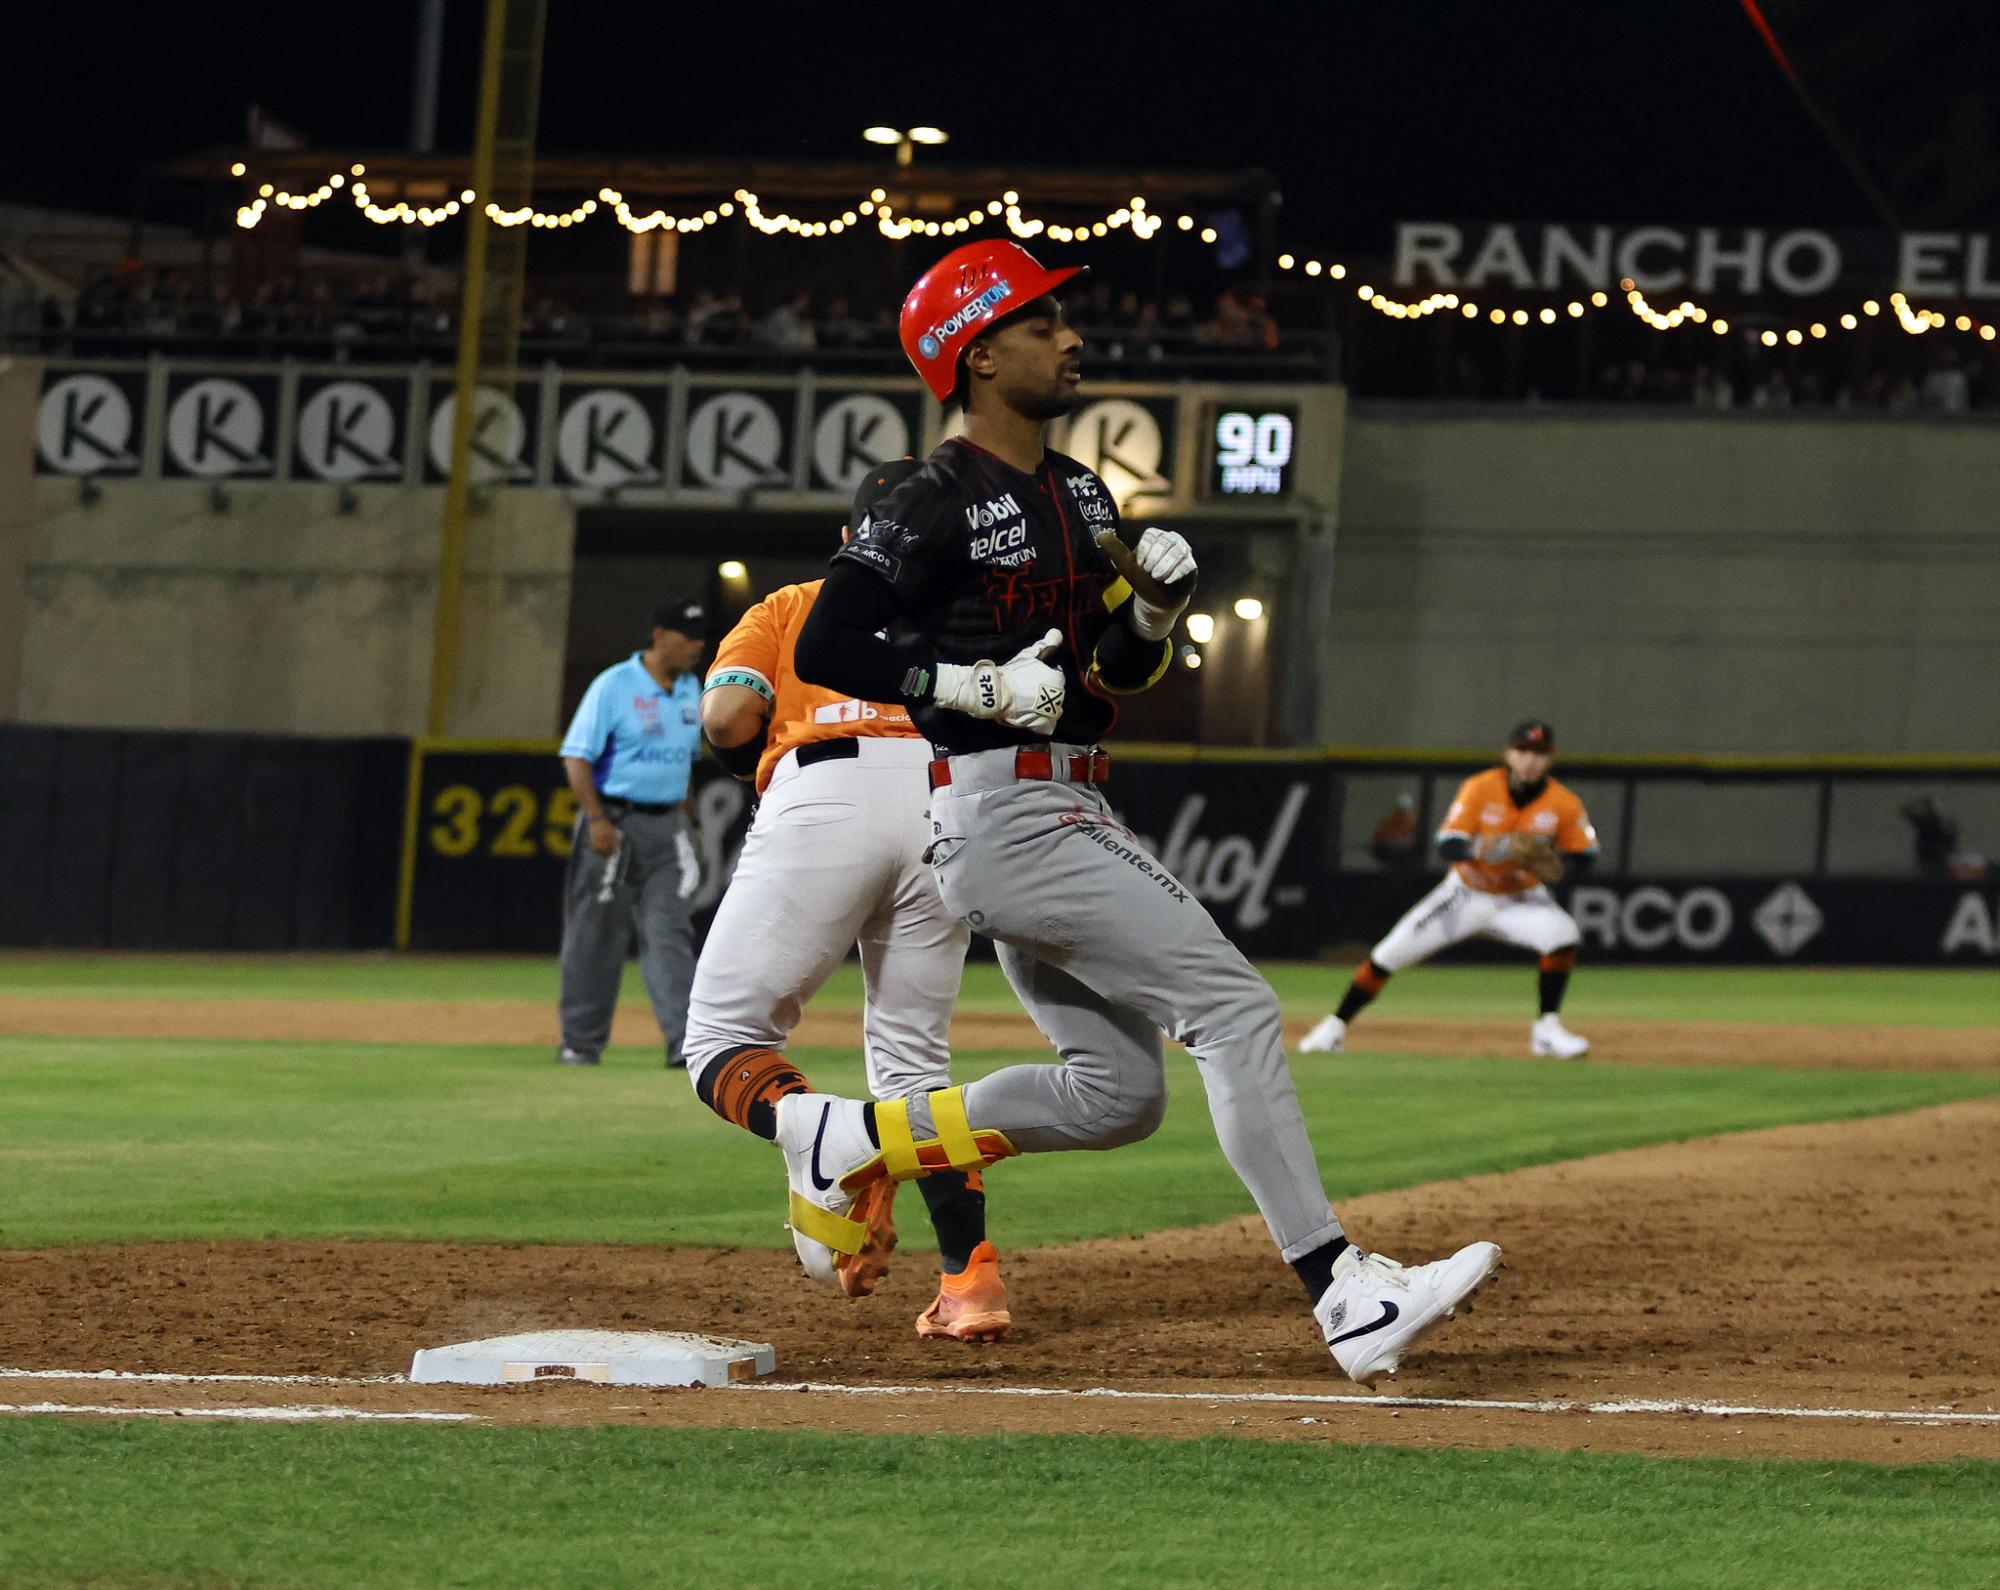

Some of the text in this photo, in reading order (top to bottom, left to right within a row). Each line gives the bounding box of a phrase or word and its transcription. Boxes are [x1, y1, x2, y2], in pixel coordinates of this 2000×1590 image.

[1392, 222, 1842, 292] RANCHO
[1216, 412, 1293, 467] 90
[970, 518, 1027, 560] telcel
[431, 784, 573, 858] 325
[1075, 821, 1190, 904] aliente.mx
[1568, 885, 1735, 952] RCO
